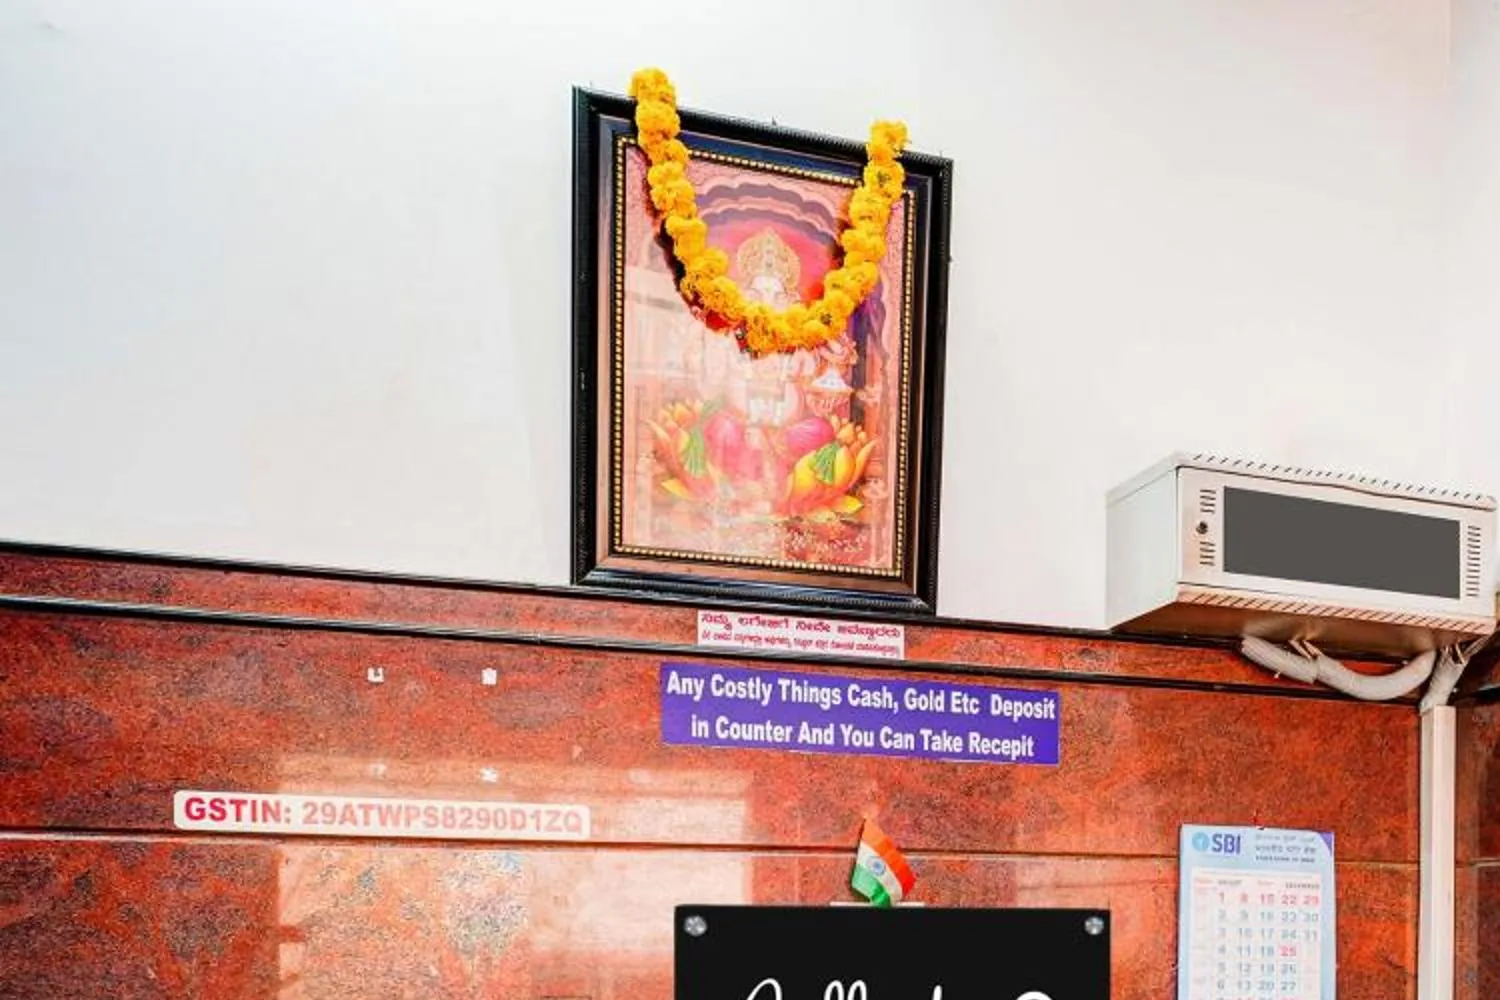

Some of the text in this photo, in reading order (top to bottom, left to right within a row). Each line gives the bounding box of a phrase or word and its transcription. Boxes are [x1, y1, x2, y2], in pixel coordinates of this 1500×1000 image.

[667, 670, 1055, 722] Any Costly Things Cash, Gold Etc Deposit
[715, 715, 792, 744] Counter
[799, 721, 834, 745] And
[839, 724, 874, 747] You
[879, 727, 915, 750] Can
[920, 729, 963, 753] Take
[969, 734, 1035, 761] Recepit
[184, 796, 291, 824] GSTIN:
[1211, 833, 1241, 855] SBI
